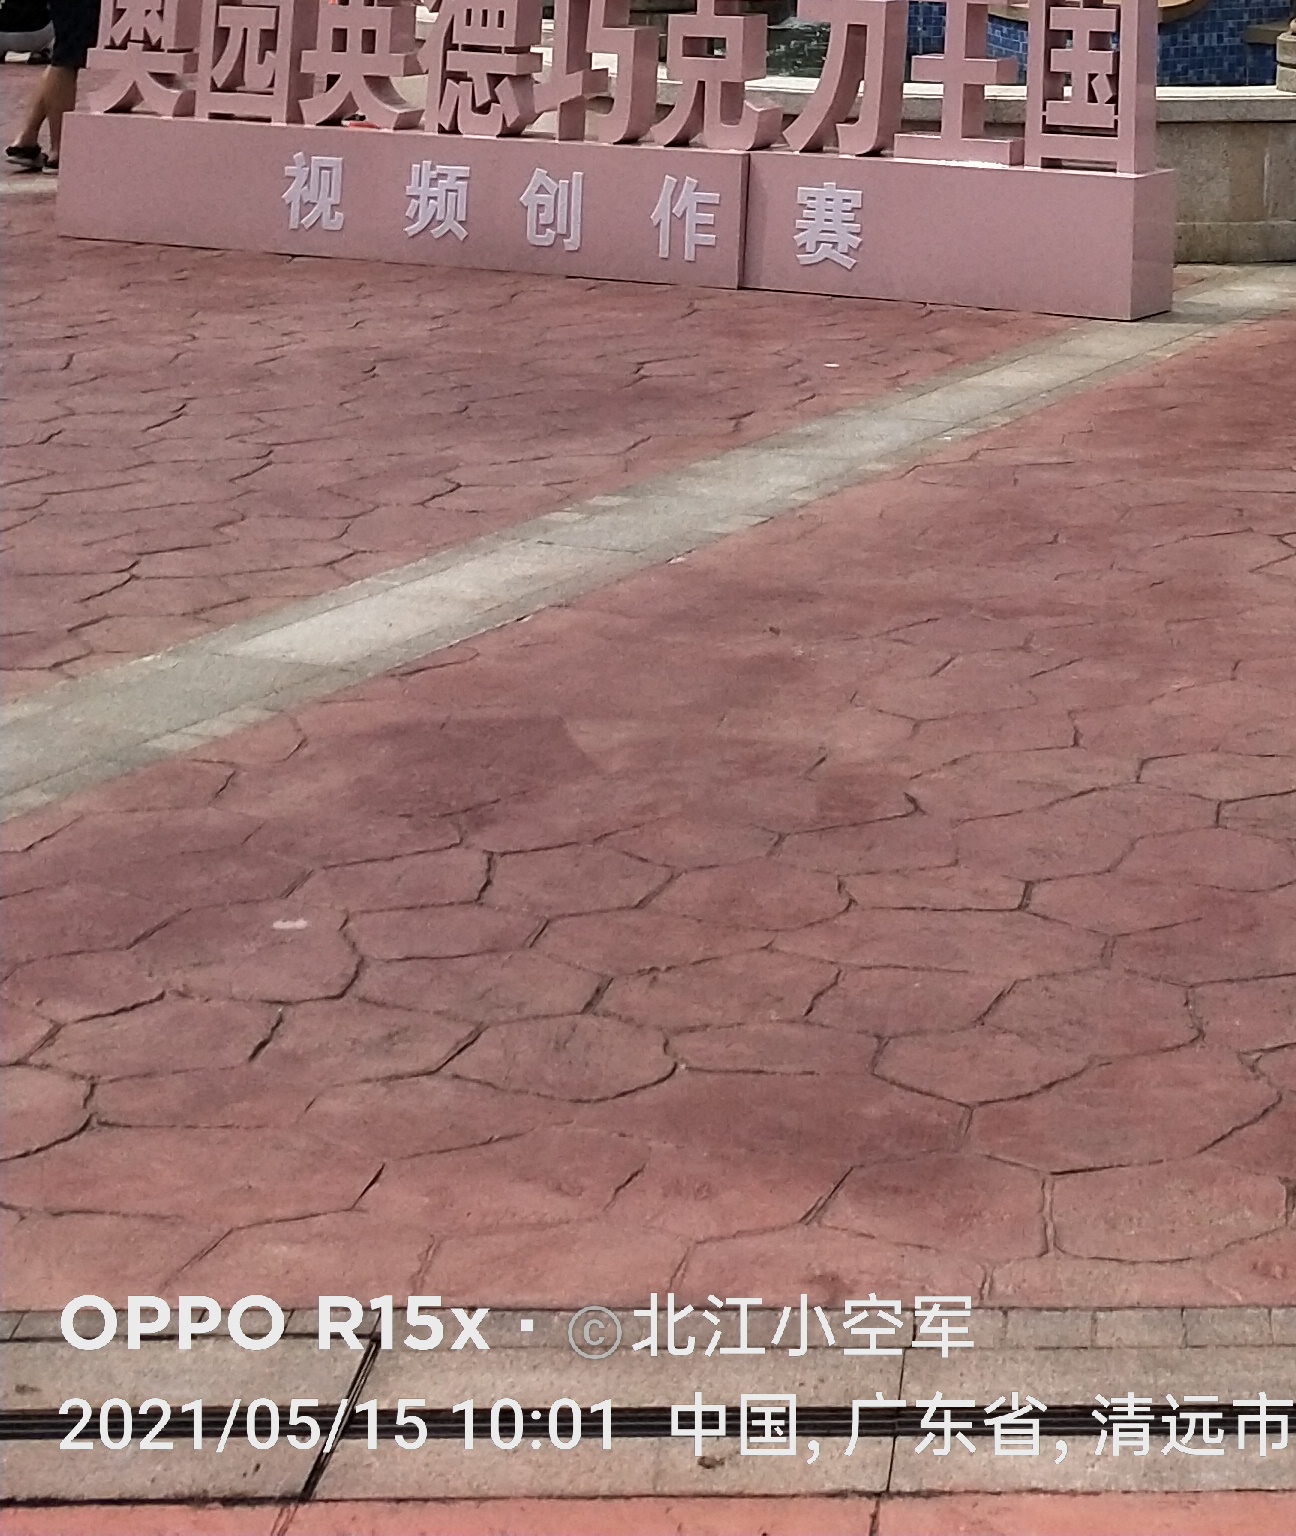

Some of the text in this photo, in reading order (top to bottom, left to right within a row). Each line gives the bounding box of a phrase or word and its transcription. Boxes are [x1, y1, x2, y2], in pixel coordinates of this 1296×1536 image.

[282, 151, 864, 270] 视频创作赛
